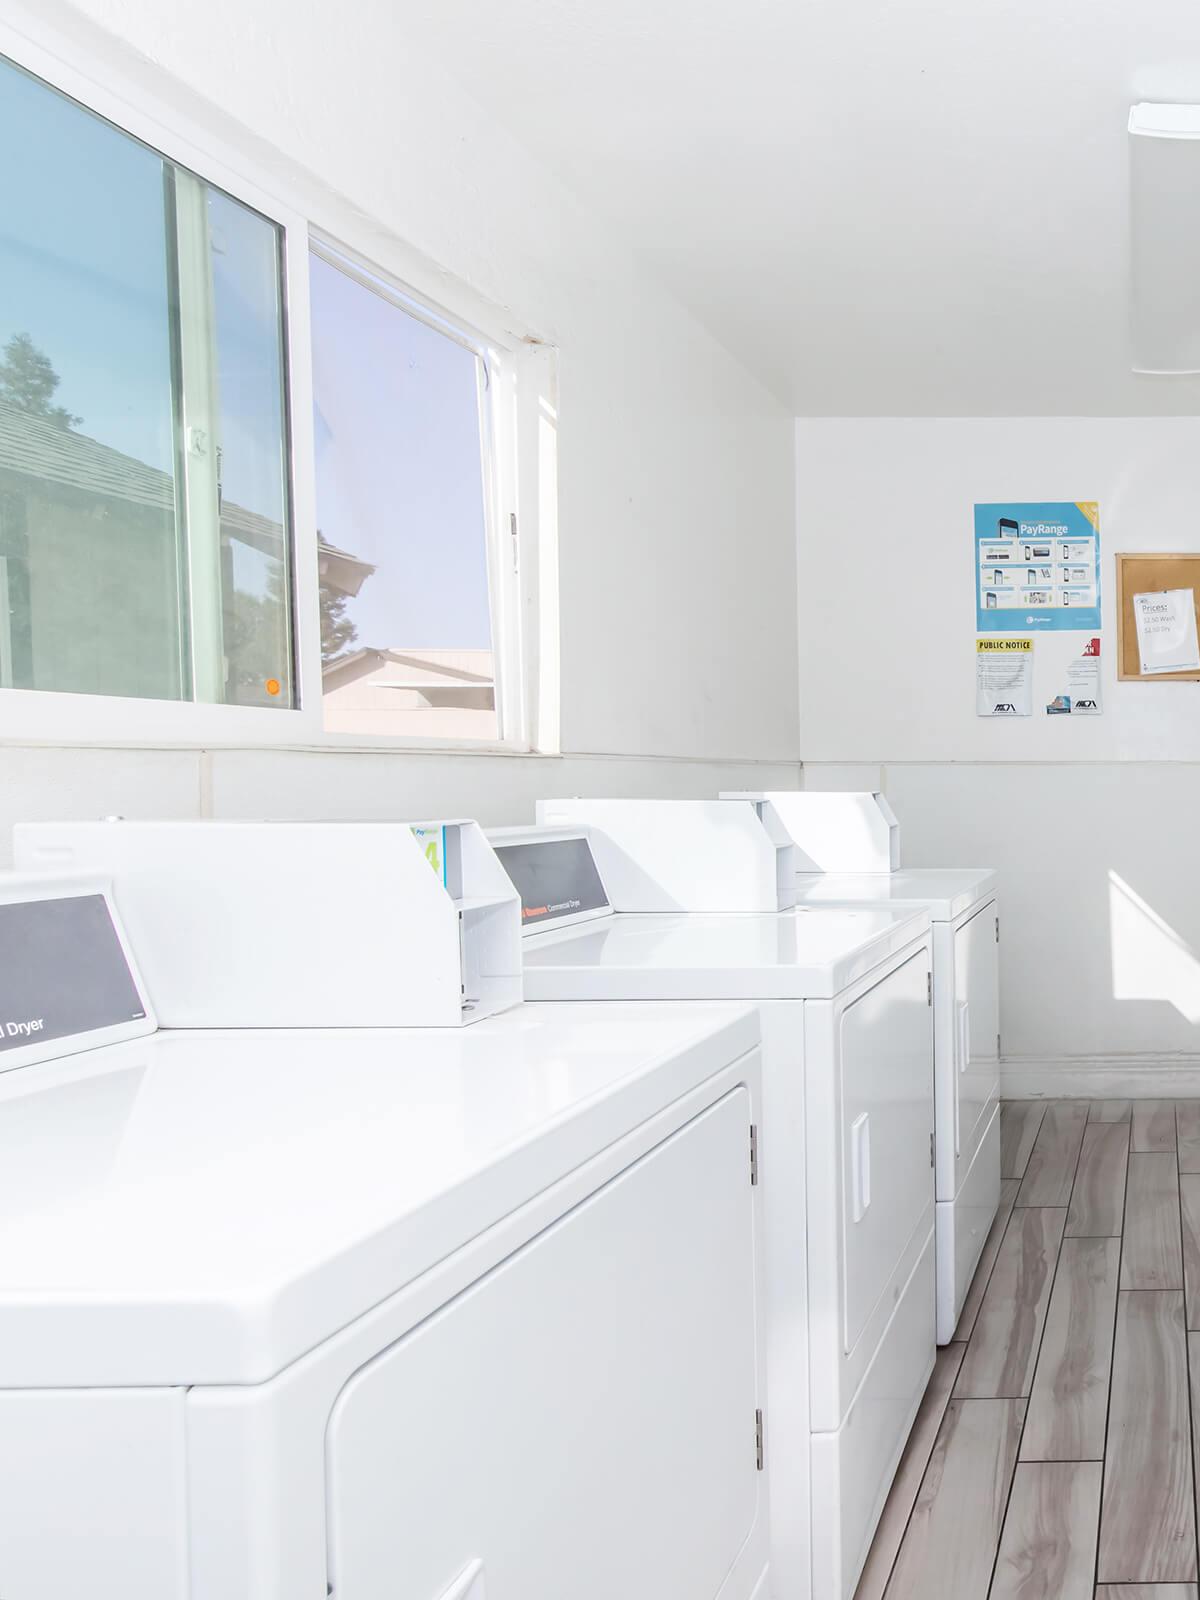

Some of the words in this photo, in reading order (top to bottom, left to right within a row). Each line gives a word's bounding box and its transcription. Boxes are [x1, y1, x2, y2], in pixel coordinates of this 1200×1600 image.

[1020, 524, 1068, 536] PayRange
[1142, 604, 1168, 612] Prices:
[979, 641, 1003, 649] PUBLIC
[1005, 641, 1030, 649] NOTICE
[6, 1019, 43, 1036] Dryer
